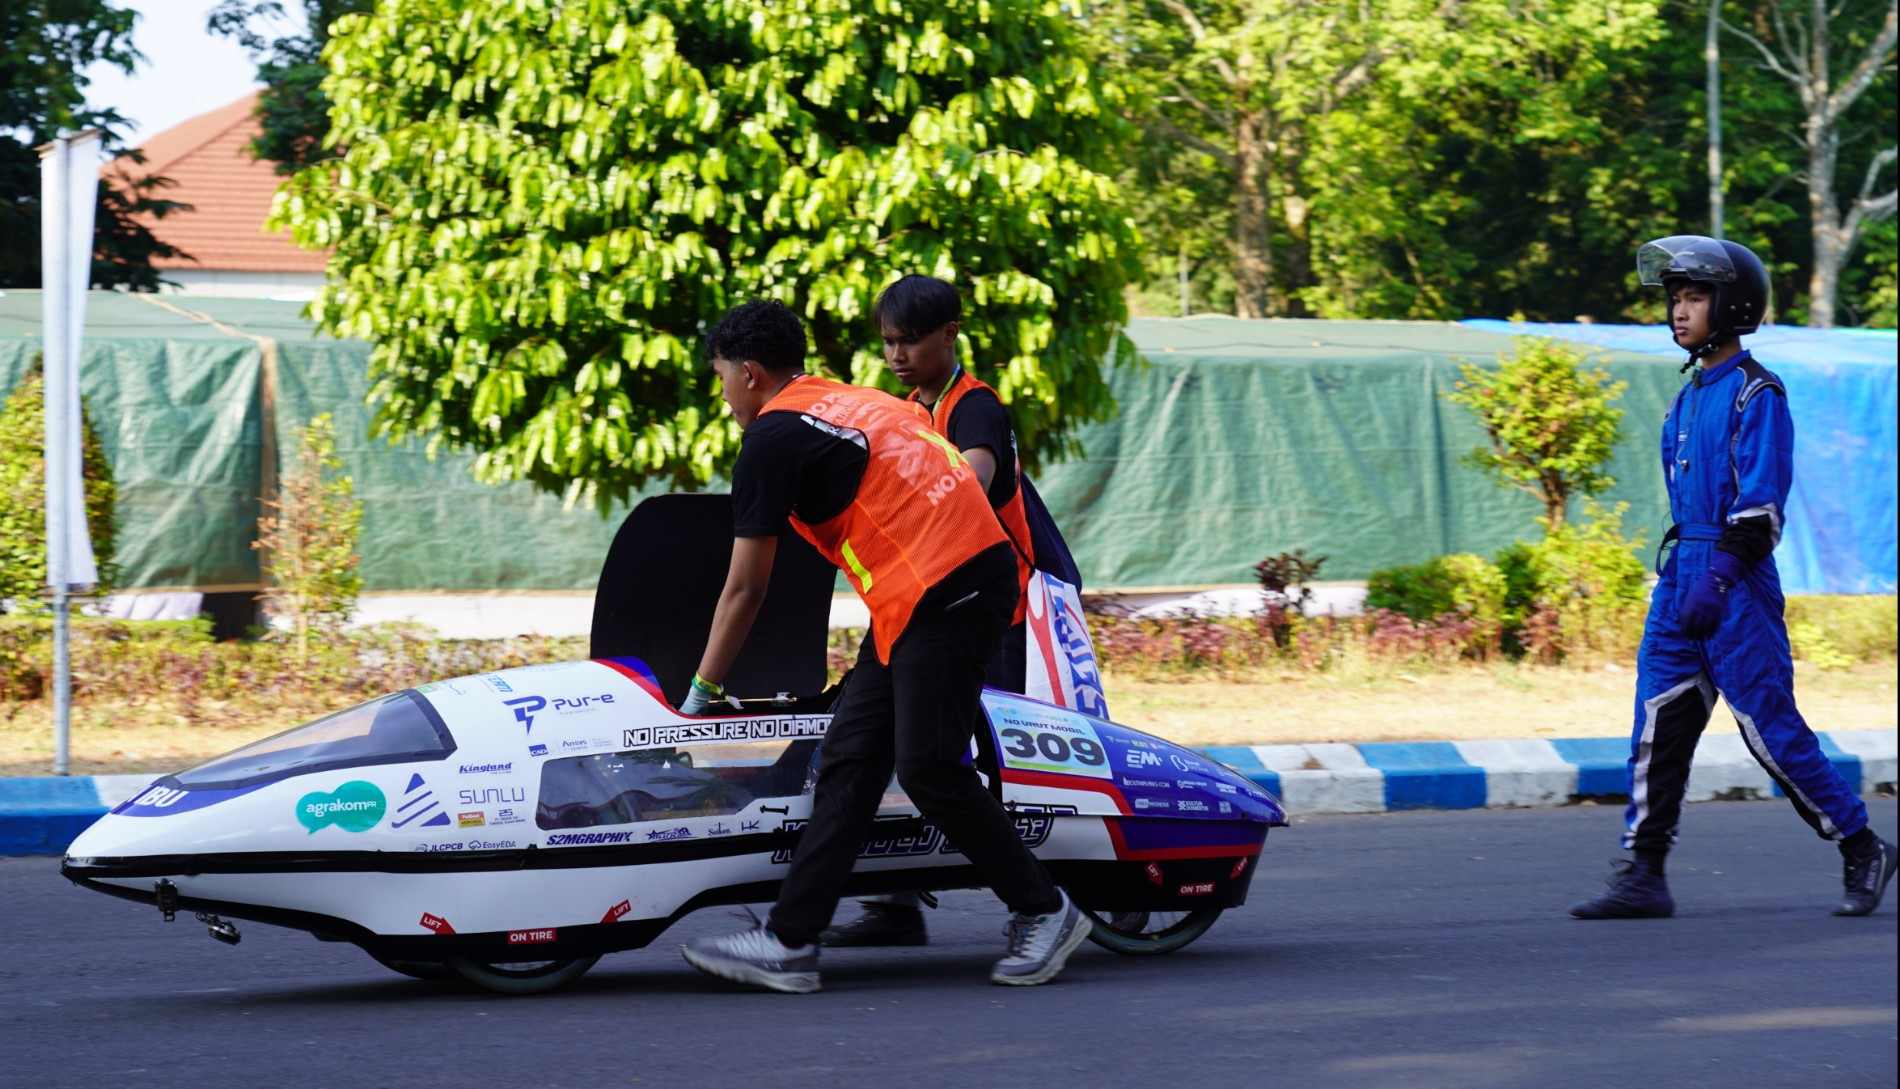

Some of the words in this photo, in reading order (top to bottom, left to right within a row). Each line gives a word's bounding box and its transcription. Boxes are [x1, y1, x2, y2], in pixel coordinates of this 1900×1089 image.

[1003, 718, 1021, 726] NO
[624, 727, 651, 747] NO
[653, 721, 749, 744] PRESSURE
[750, 719, 777, 738] NO
[779, 717, 832, 737] DIAMO
[1001, 728, 1105, 766] 309
[459, 762, 512, 774] Kingland
[483, 840, 516, 849] EasyEDA
[1180, 885, 1194, 894] ON
[1195, 884, 1213, 893] TIRE
[614, 903, 630, 916] LIFT
[423, 917, 442, 930] LIFT
[510, 932, 527, 942] ON
[529, 930, 553, 941] TIRE
